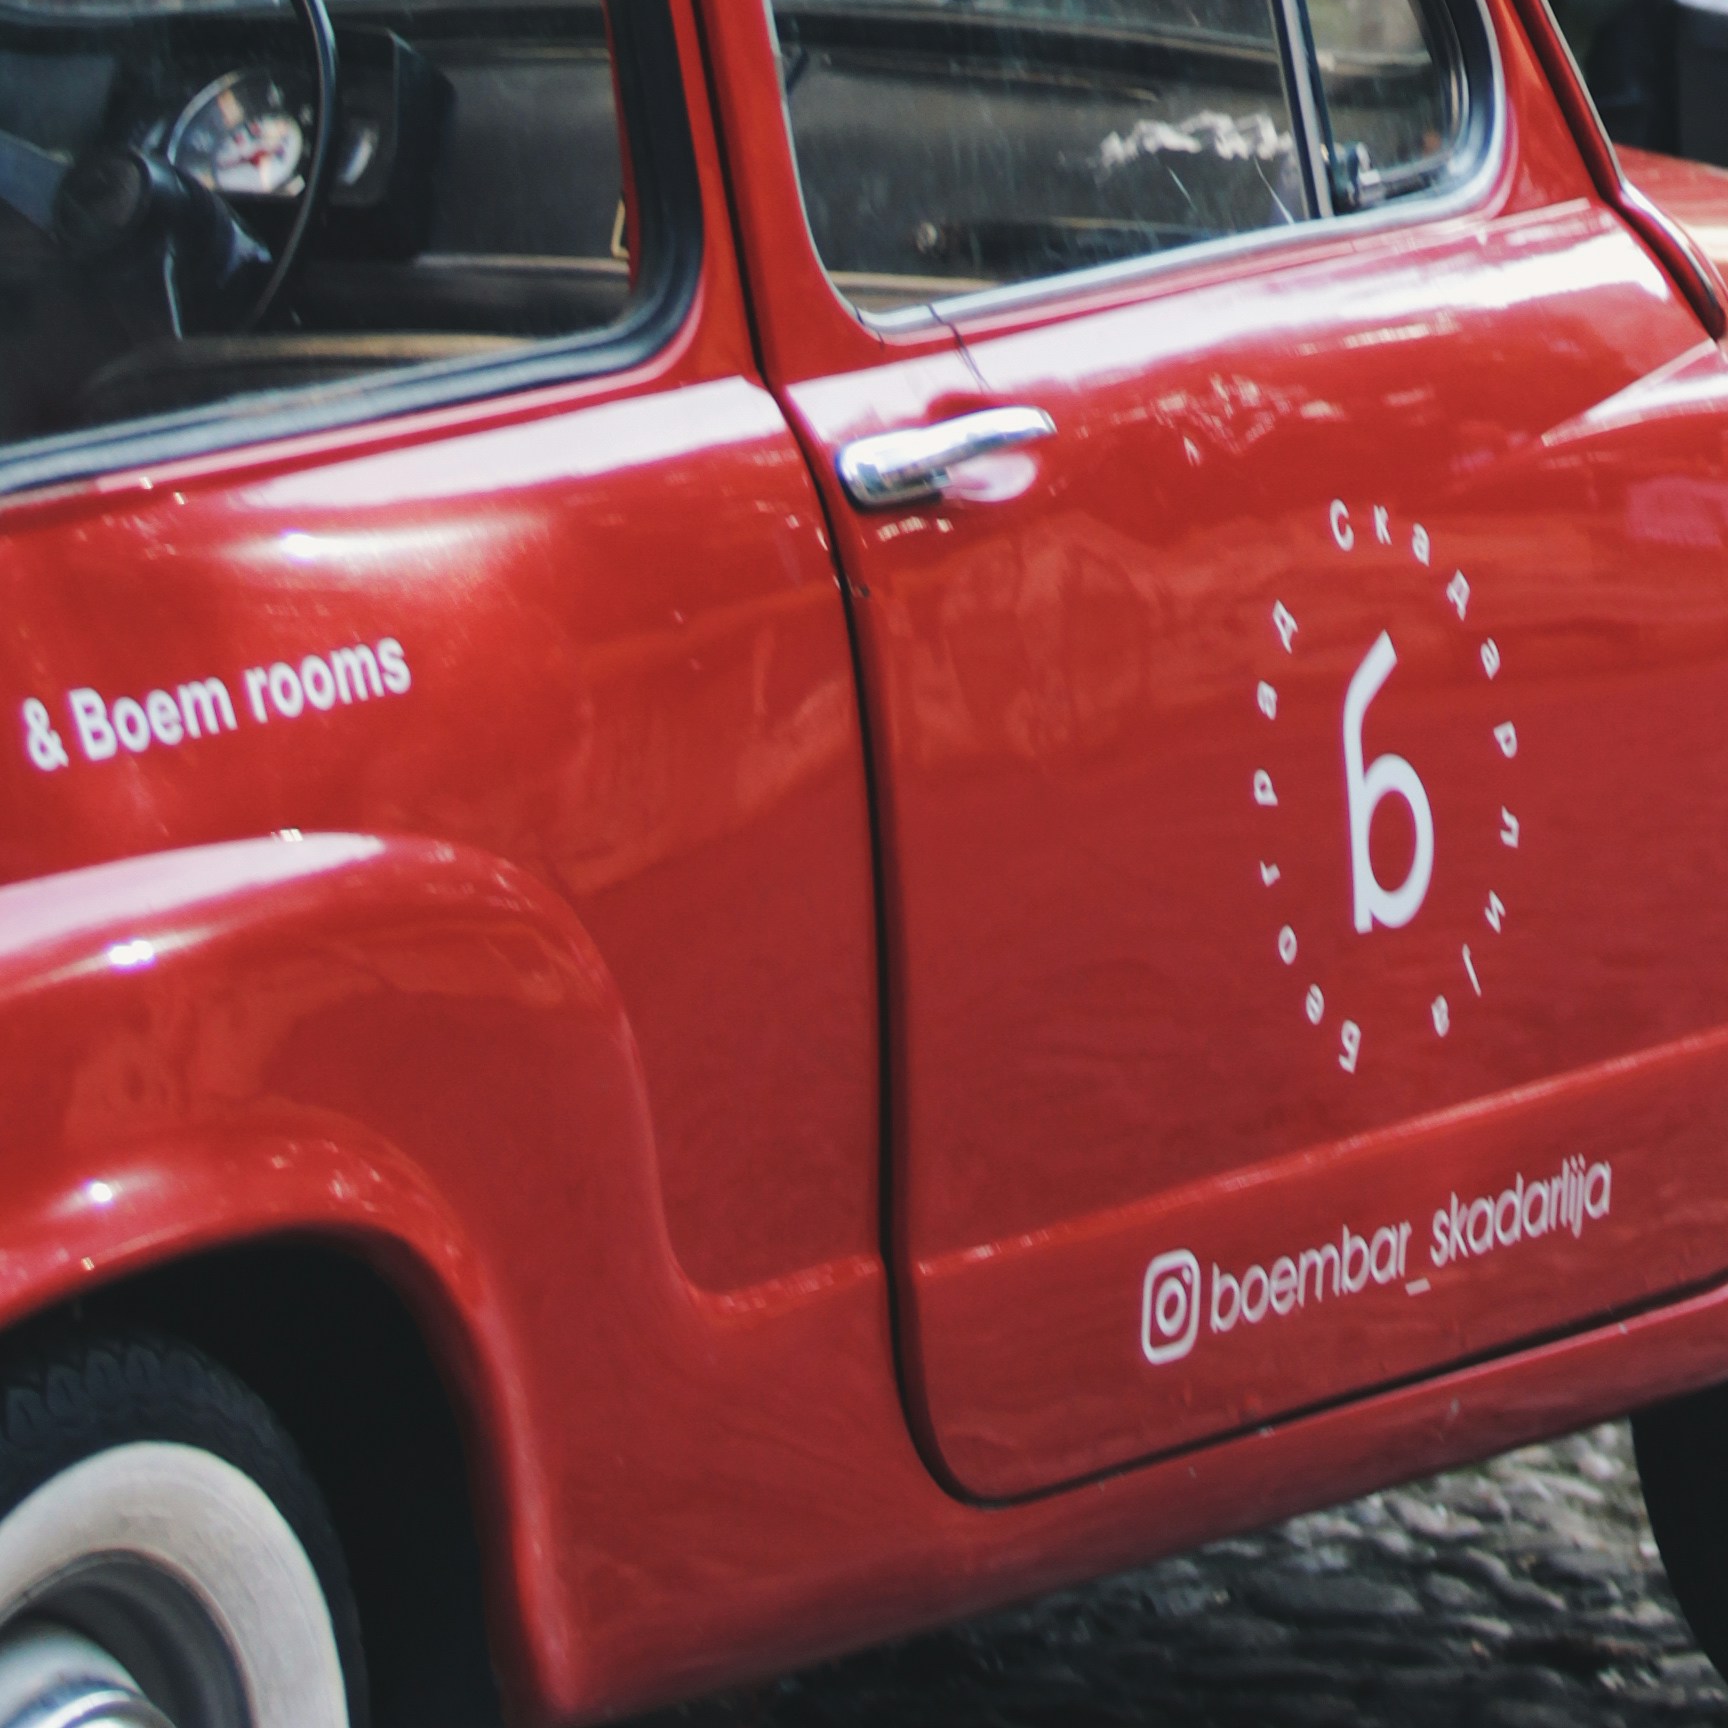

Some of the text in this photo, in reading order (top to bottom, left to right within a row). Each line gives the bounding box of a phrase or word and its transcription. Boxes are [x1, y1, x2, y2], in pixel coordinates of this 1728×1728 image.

[21, 636, 412, 772] & Boem rooms
[1210, 1153, 1612, 1334] boembar_skadarlija
